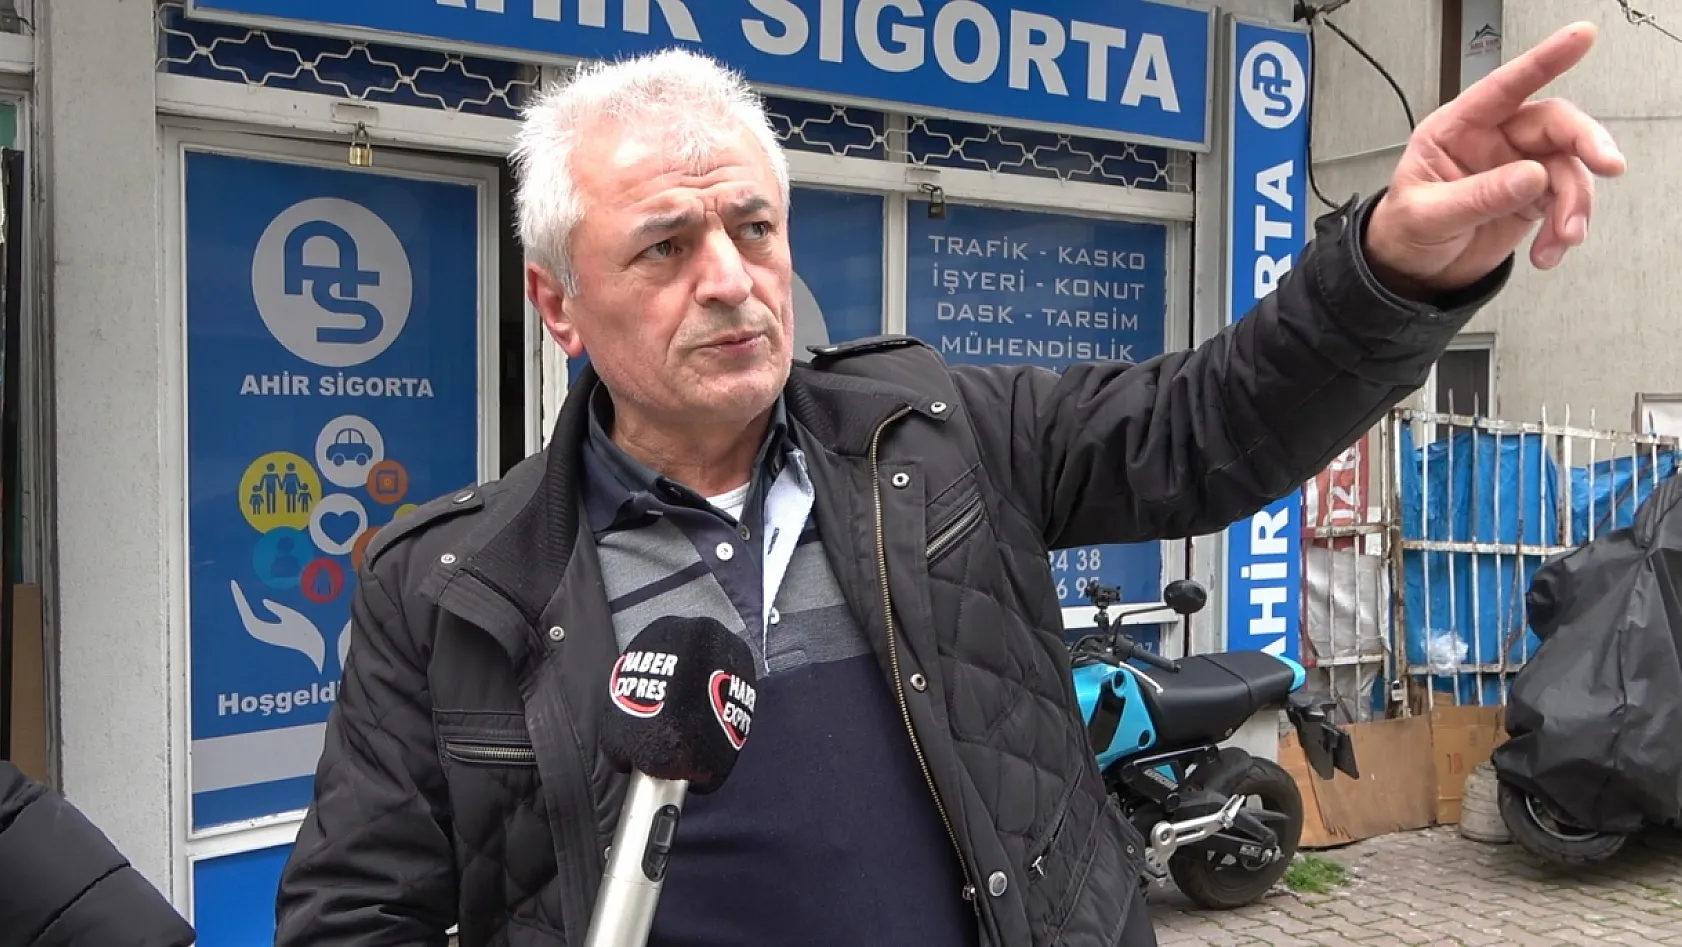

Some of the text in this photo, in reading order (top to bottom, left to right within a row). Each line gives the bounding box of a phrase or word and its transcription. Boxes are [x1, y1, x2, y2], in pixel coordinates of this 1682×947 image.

[928, 235, 1029, 261] TRAFİK
[1058, 246, 1146, 270] KASKO
[933, 263, 1025, 294] İŞYERİ
[1055, 278, 1145, 300] KONUT
[937, 302, 1014, 324] DASK
[1041, 307, 1139, 331] TARSİM
[941, 330, 1135, 361] MÜHENDİSLİK
[240, 370, 434, 397] AHİR SİGORTA
[1076, 548, 1101, 571] 38
[1240, 507, 1288, 657] HİR
[621, 651, 678, 676] HABER
[217, 680, 341, 716] Hoşgeldi
